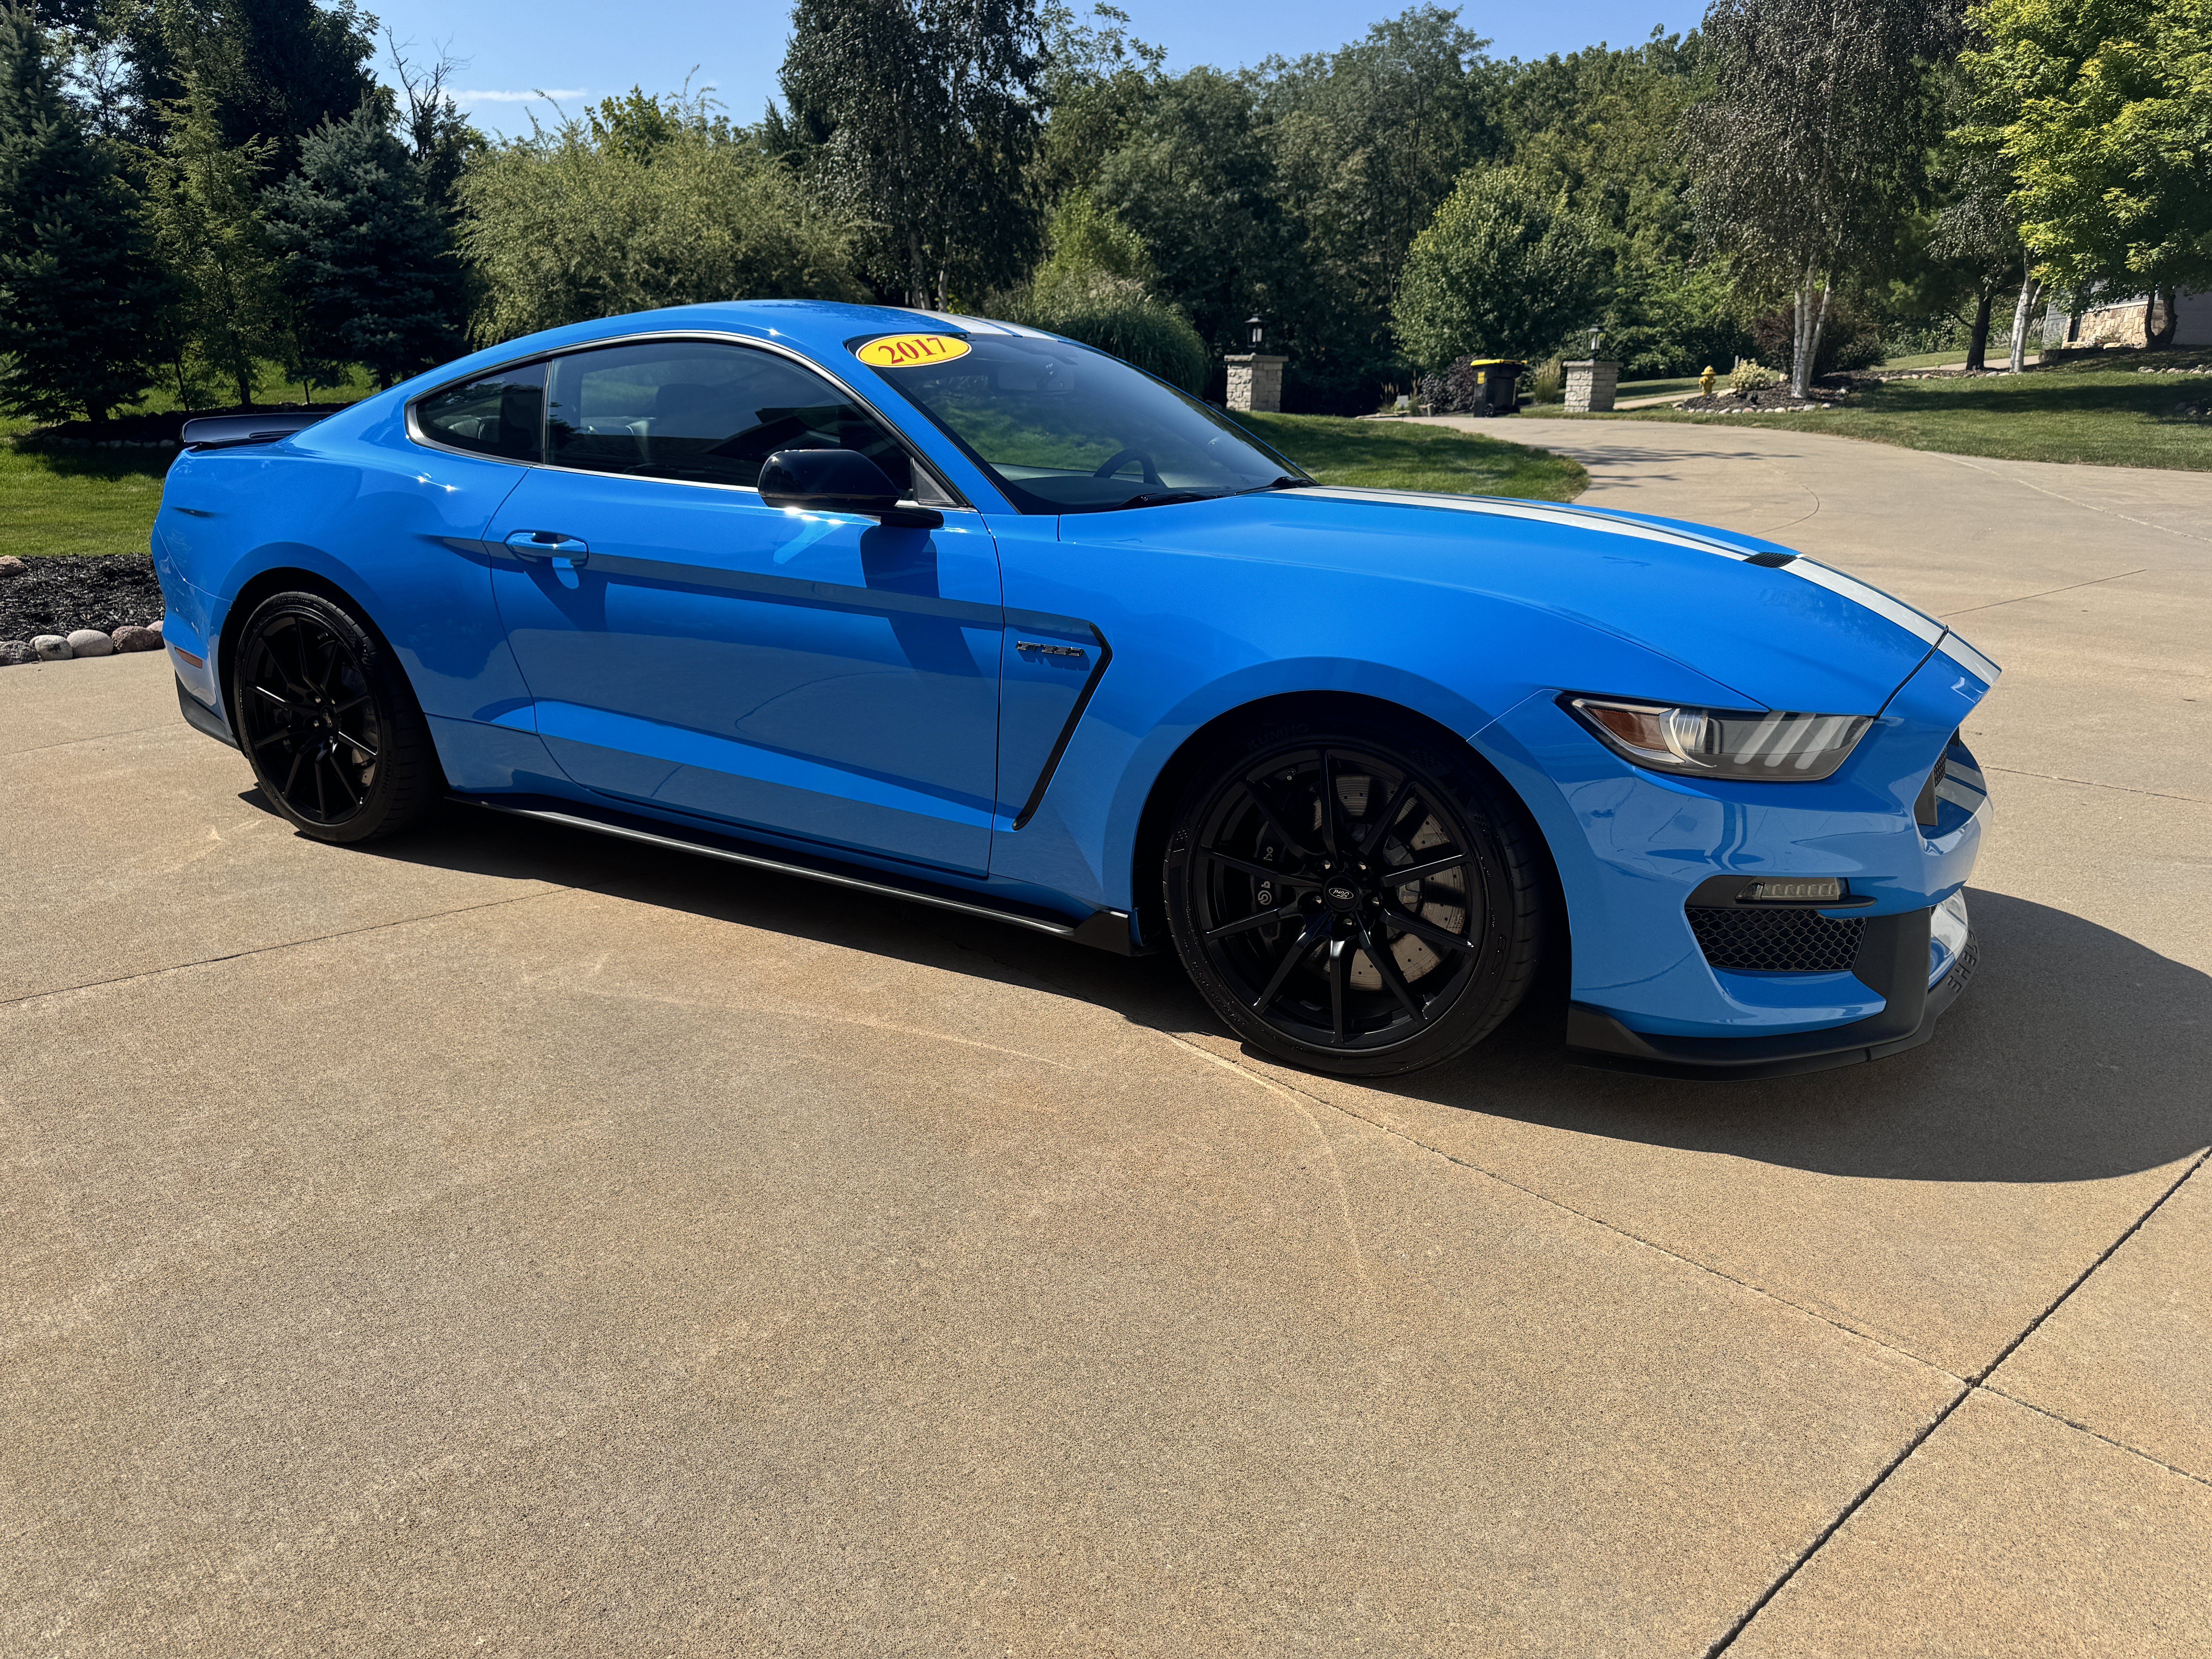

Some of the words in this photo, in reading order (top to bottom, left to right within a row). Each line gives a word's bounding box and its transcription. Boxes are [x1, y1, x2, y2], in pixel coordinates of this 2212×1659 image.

[879, 337, 946, 364] 2017
[1247, 723, 1310, 750] KUMHO
[382, 750, 392, 793] KUMHO
[1333, 889, 1349, 898] Ford
